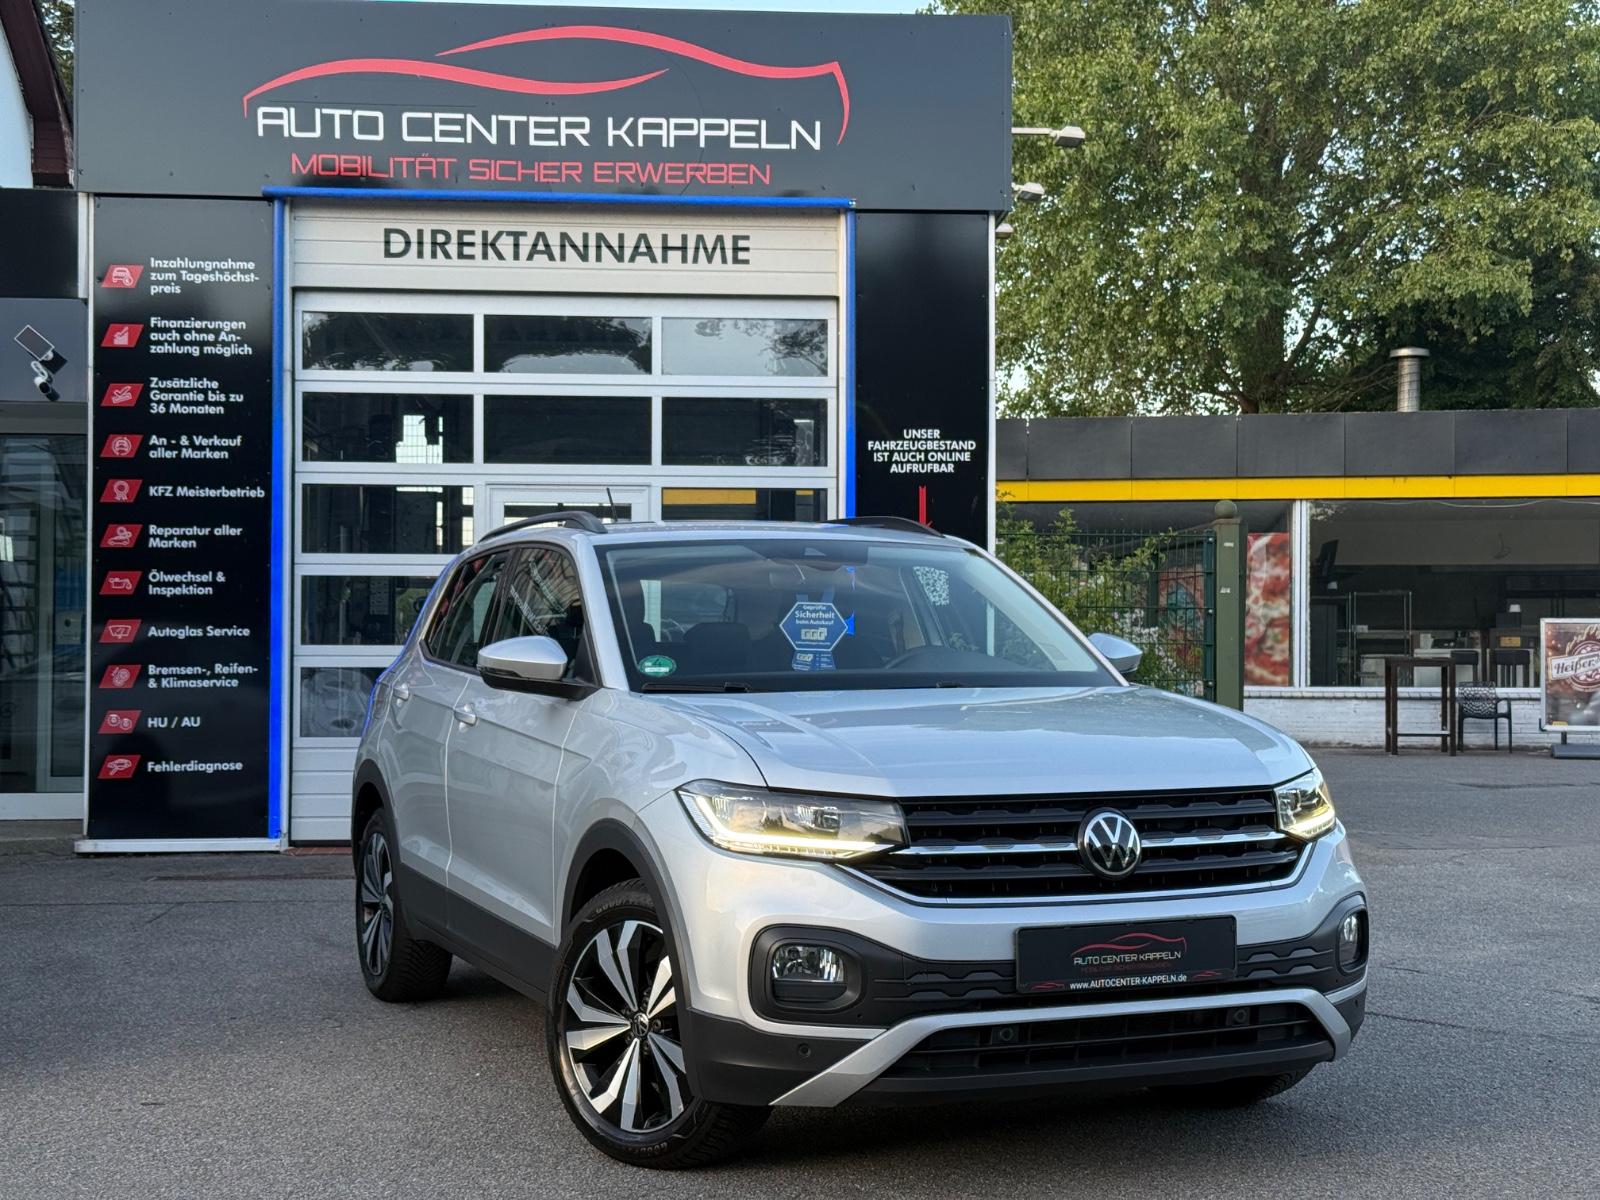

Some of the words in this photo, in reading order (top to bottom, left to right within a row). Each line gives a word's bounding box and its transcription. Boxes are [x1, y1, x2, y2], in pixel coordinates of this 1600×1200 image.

[257, 107, 384, 140] AUTO
[402, 112, 590, 146] CENTER
[608, 117, 820, 150] KAPPELN
[291, 152, 457, 178] MOBILITÄT
[469, 159, 583, 182] SICHER
[593, 161, 771, 184] ERWERBEN
[381, 227, 753, 264] DIREKTANNAHME
[151, 258, 255, 271] Inzahlungnahme
[180, 271, 259, 283] Tageshöchst-
[151, 284, 181, 295] preis
[151, 317, 246, 331] Finanzierungen
[150, 330, 180, 340] auch
[184, 330, 215, 341] ohne
[219, 331, 240, 341] An-
[150, 344, 199, 356] zahlung
[204, 344, 252, 357] möglich
[150, 378, 218, 389] Zusätzliche
[150, 391, 204, 402] Garantie
[208, 391, 226, 401] bis
[150, 404, 165, 413] 36
[170, 404, 224, 414] Monaten
[904, 429, 940, 439] UNSER
[149, 435, 167, 446] An
[180, 435, 189, 445] &
[193, 435, 241, 446] Verkauf
[868, 441, 976, 450] FAHRZEUGBESTAND
[149, 448, 178, 458] aller
[181, 448, 228, 458] Marken
[874, 452, 889, 462] IST
[892, 452, 924, 461] AUCH
[928, 452, 970, 461] ONLINE
[890, 463, 954, 473] AUFRUFBAR
[150, 486, 173, 496] KFZ
[177, 486, 265, 497] Meisterbetrieb
[149, 525, 211, 537] Reparatur
[214, 525, 242, 535] aller
[149, 538, 196, 548] Marken
[149, 569, 212, 582] Ölwechsel
[216, 572, 225, 582] &
[149, 584, 212, 597] Inspektion
[148, 626, 203, 639] Autoglas
[207, 627, 250, 636] Service
[149, 665, 210, 676] Bremsen-,
[215, 663, 258, 674] Reifen-
[148, 678, 157, 688] &
[162, 676, 238, 688] Klimaservice
[148, 717, 167, 727] HU
[181, 717, 200, 727] AU
[148, 761, 243, 773] Fehlerdiagnose
[1074, 956, 1100, 965] AUTO
[1101, 954, 1137, 963] CENTER
[1139, 951, 1181, 960] KAPPELN
[1070, 974, 1187, 990] www.AUTOCENTER-KAPPELN.de
